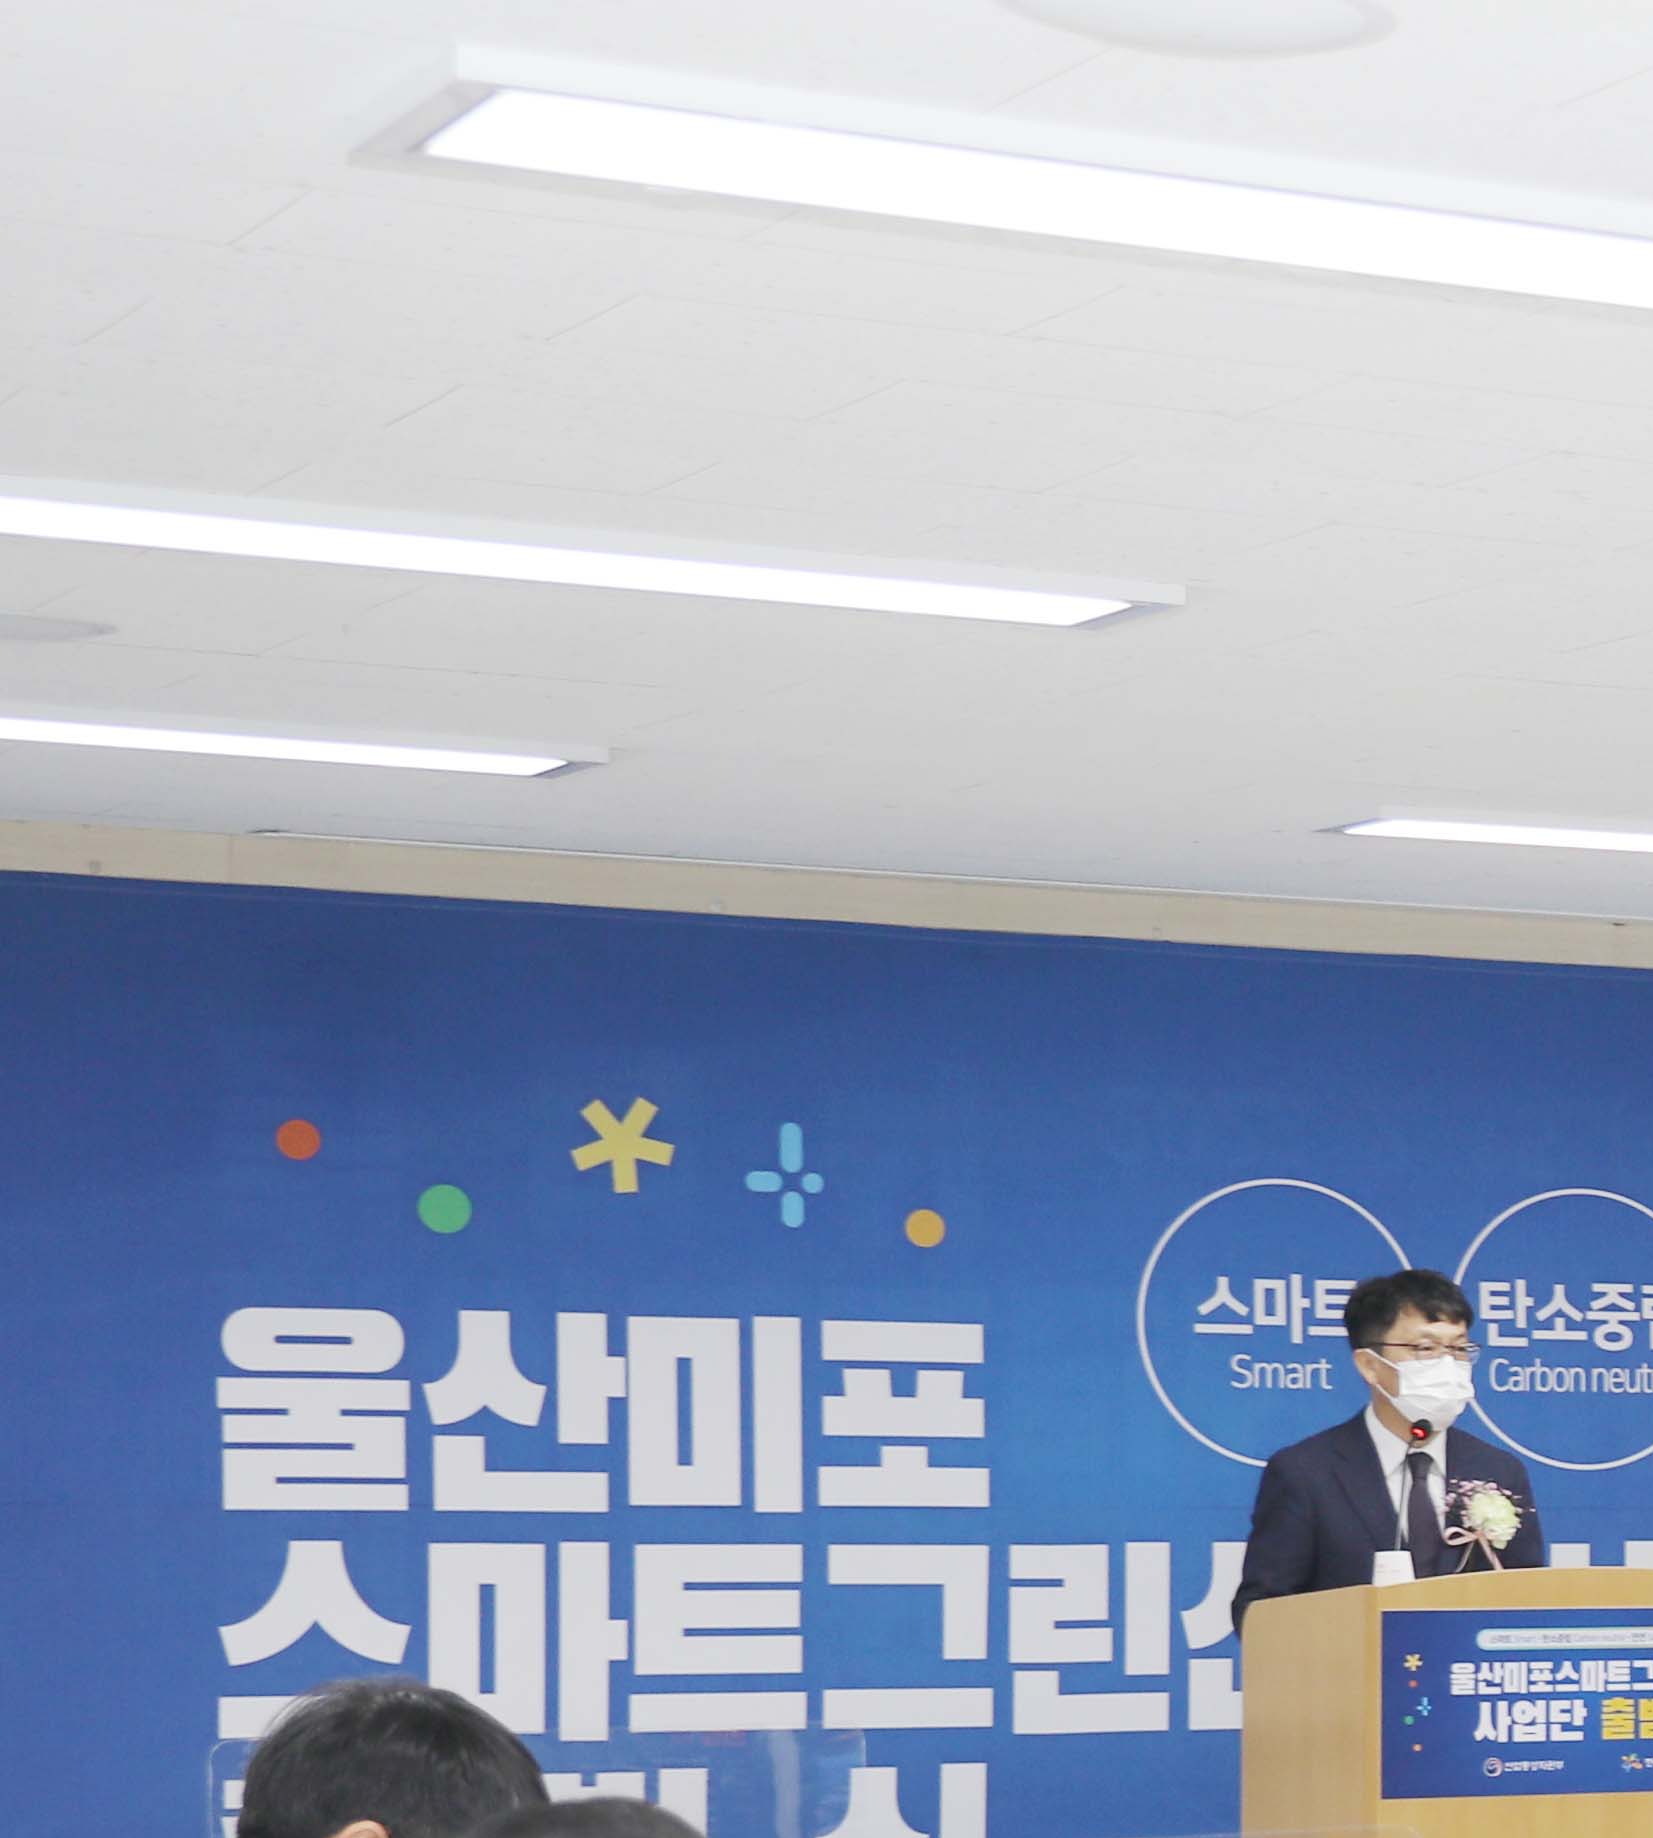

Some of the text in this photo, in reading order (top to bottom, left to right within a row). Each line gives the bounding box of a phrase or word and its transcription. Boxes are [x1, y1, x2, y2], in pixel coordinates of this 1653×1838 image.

[1194, 1273, 1357, 1344] 스마트
[1230, 1353, 1333, 1390] Smart
[1488, 1358, 1586, 1393] Carbon
[216, 1306, 991, 1513] 울산미포
[1472, 1698, 1589, 1744] 사업단
